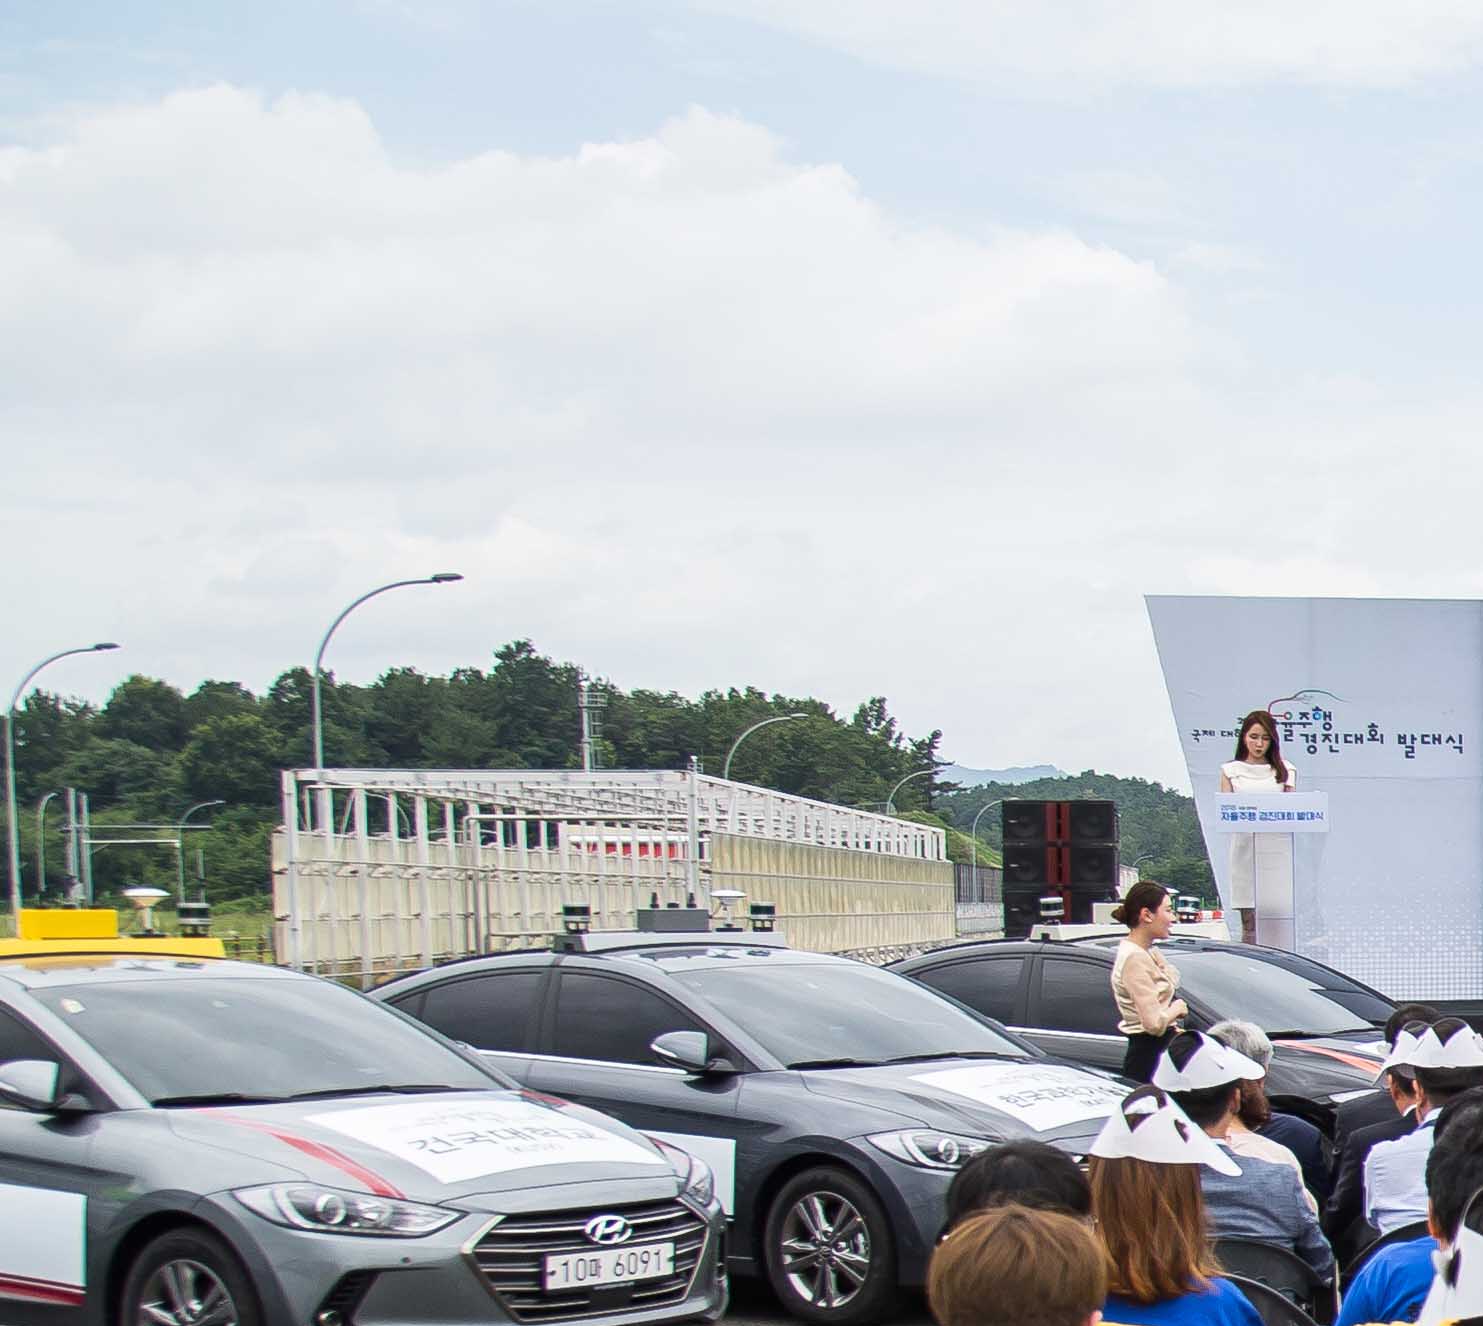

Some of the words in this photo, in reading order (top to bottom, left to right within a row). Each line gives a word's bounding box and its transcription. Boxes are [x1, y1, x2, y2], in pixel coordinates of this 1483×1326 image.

[1301, 723, 1384, 754] 경진대회
[1398, 734, 1463, 759] 발대식
[613, 1250, 663, 1278] 6091
